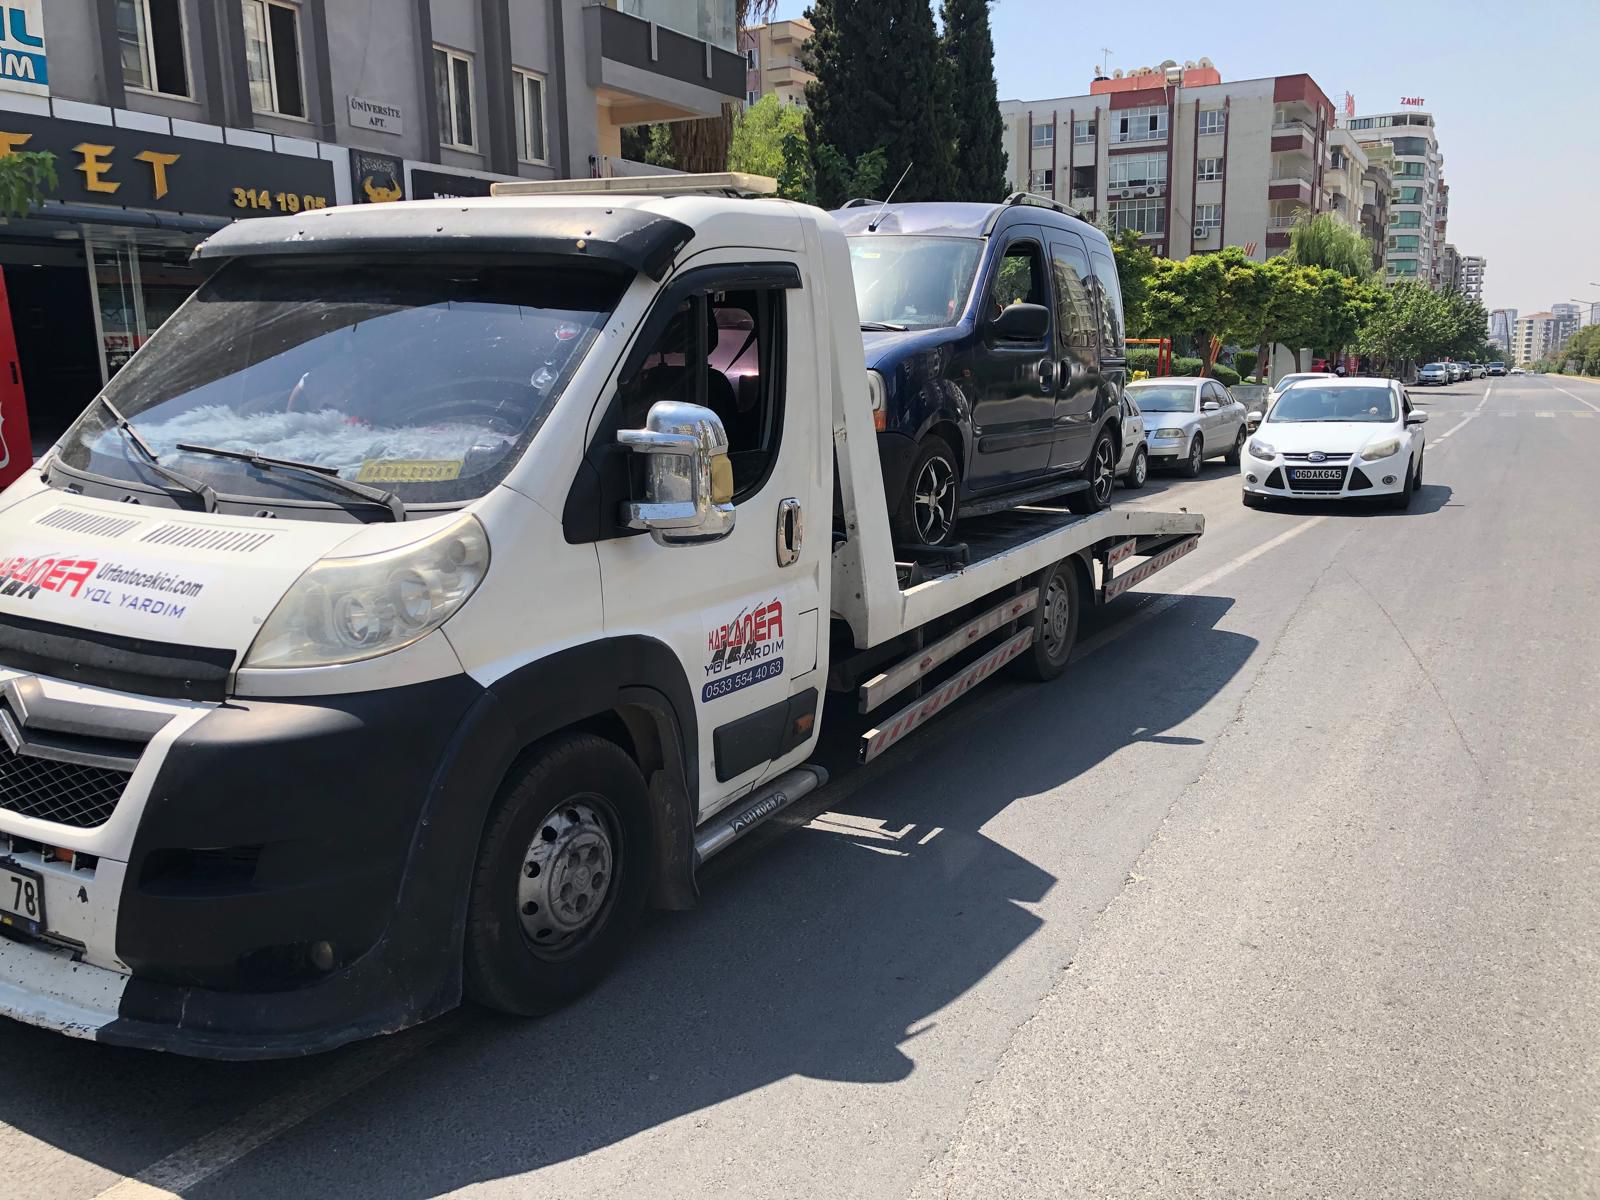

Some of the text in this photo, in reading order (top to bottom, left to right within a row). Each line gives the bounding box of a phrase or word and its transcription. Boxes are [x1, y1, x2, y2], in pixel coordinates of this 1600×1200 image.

[369, 117, 387, 128] APT.
[232, 187, 272, 209] 314
[275, 192, 300, 212] 19
[1295, 470, 1341, 479] 06DAK645
[96, 562, 204, 598] Urfaotocekici.com
[83, 587, 187, 619] YOL YARDIM
[708, 601, 784, 651] KAPLANER
[737, 639, 784, 665] YARDIM
[706, 661, 781, 698] 0533 554 40 63
[11, 876, 36, 917] 78
